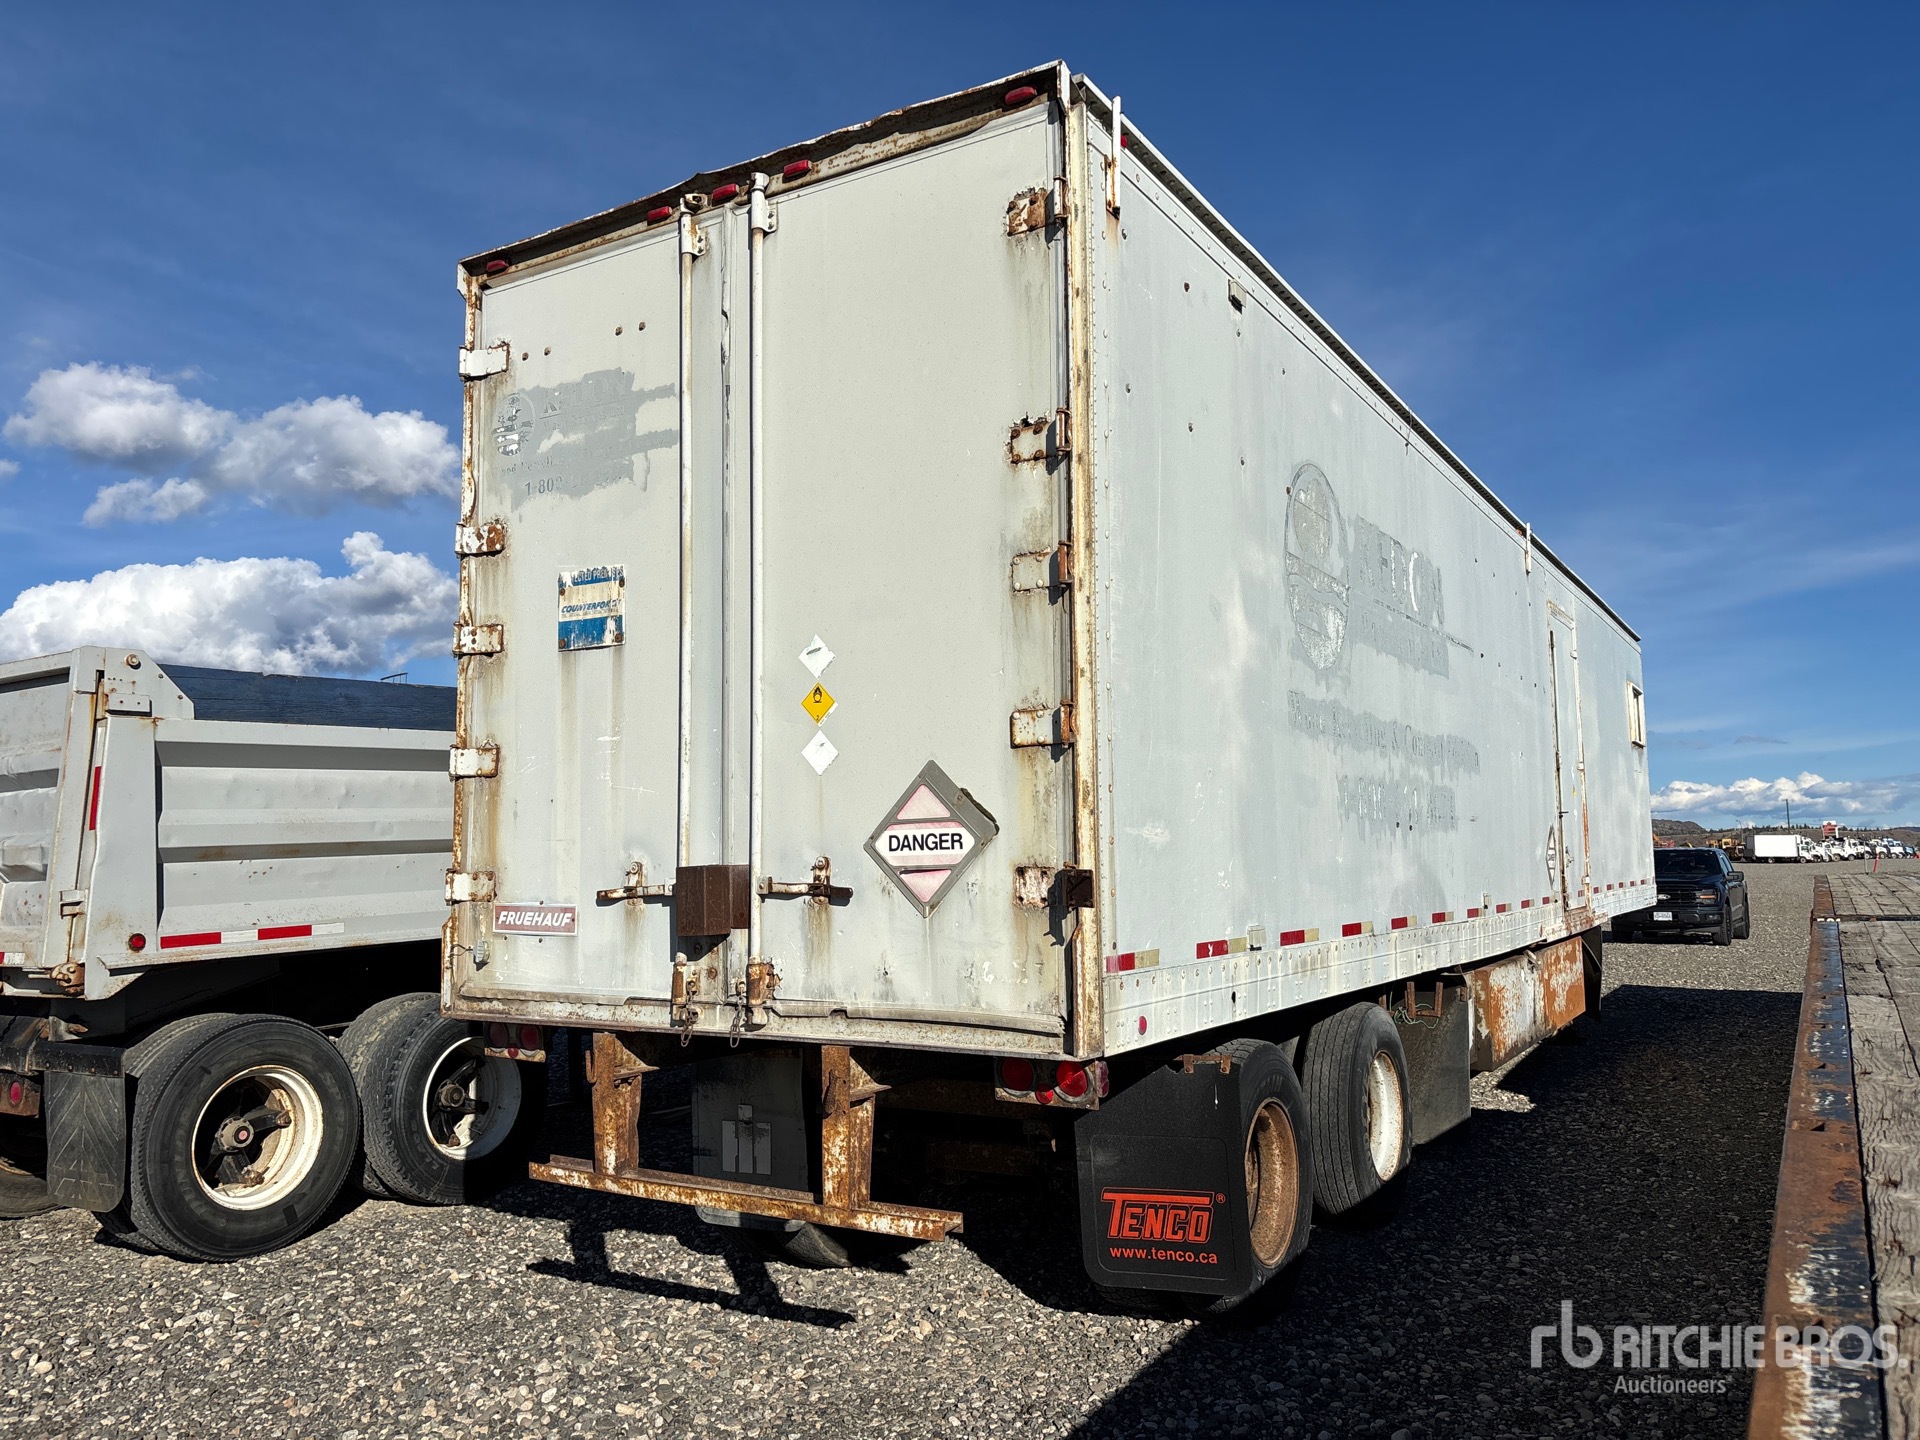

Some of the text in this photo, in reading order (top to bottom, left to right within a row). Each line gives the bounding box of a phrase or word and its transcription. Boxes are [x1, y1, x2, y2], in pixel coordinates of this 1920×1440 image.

[561, 599, 621, 613] COUNTERFOR
[888, 832, 963, 852] DANGER
[497, 910, 572, 927] FRUEHAUF
[1101, 1187, 1214, 1243] TENCO
[1109, 1247, 1218, 1265] www.tenco.ca
